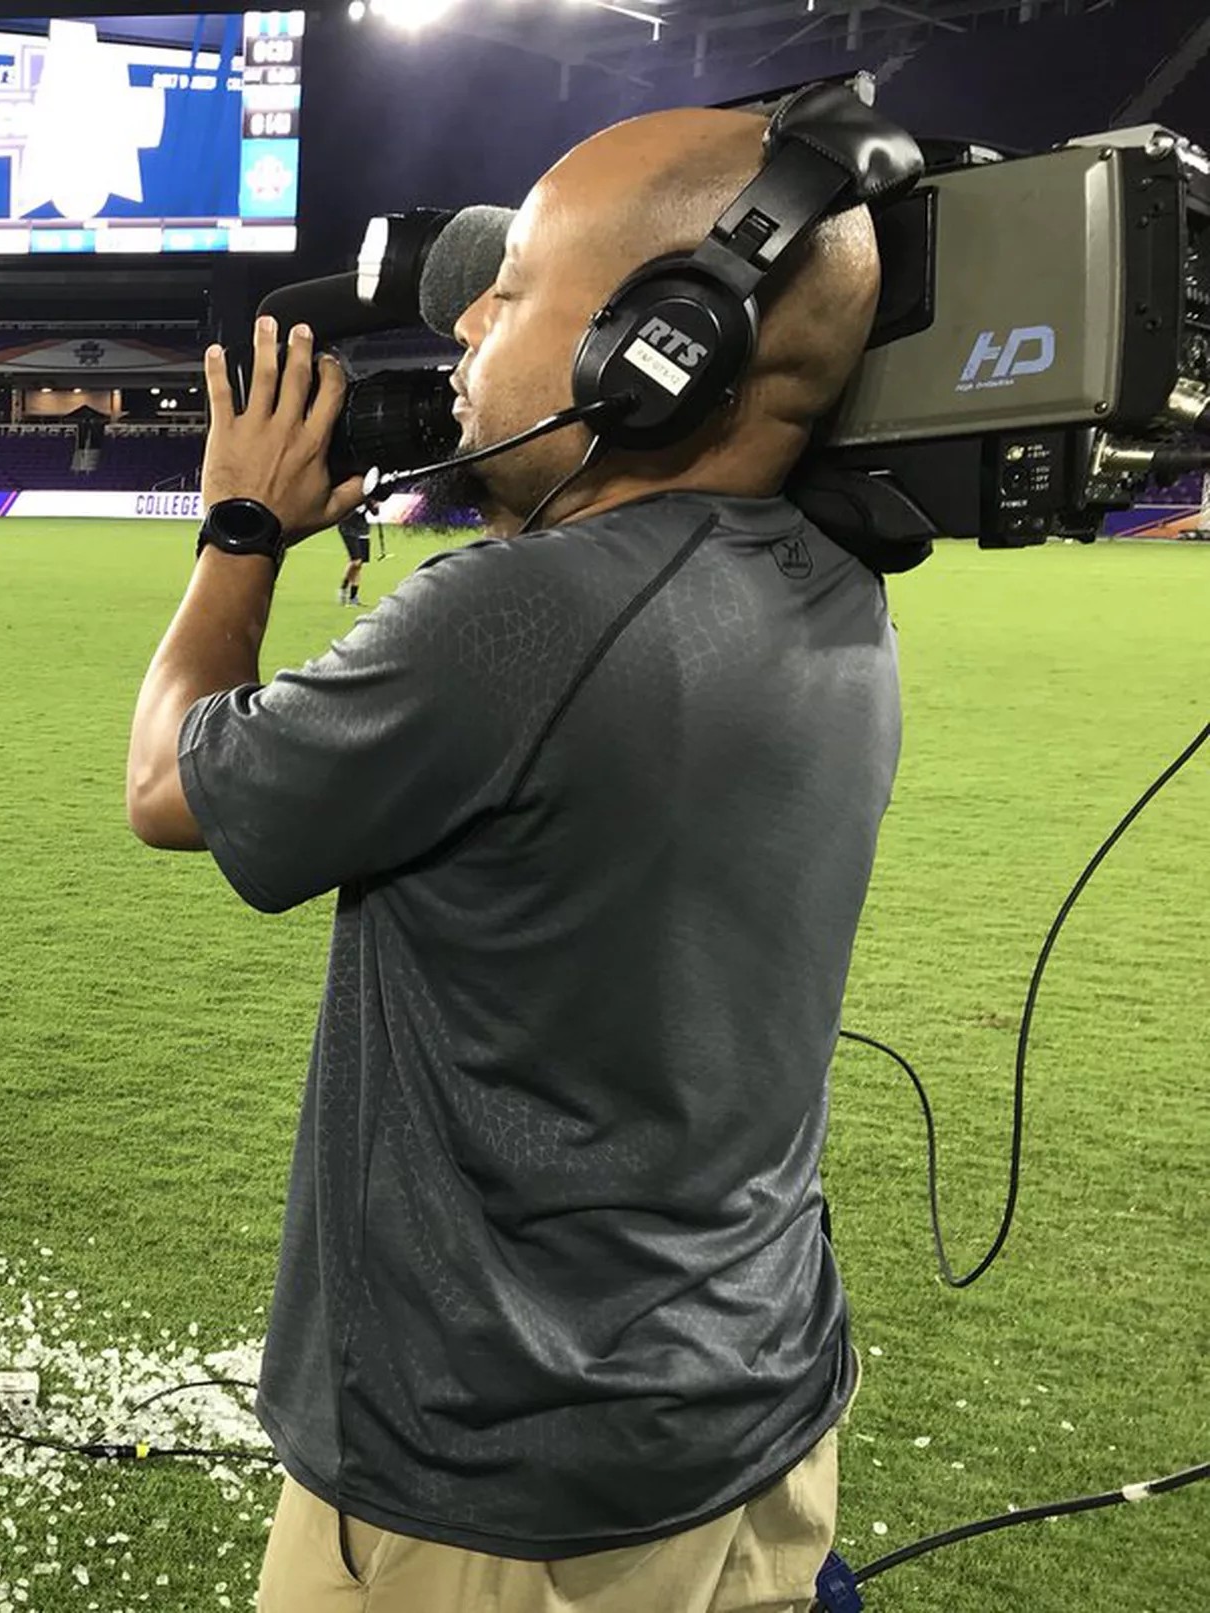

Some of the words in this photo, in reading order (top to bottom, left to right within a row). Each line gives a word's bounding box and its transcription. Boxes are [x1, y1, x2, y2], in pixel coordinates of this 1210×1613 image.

[637, 316, 709, 367] RTS
[960, 325, 1056, 381] HD
[135, 494, 201, 516] COLLEGE
